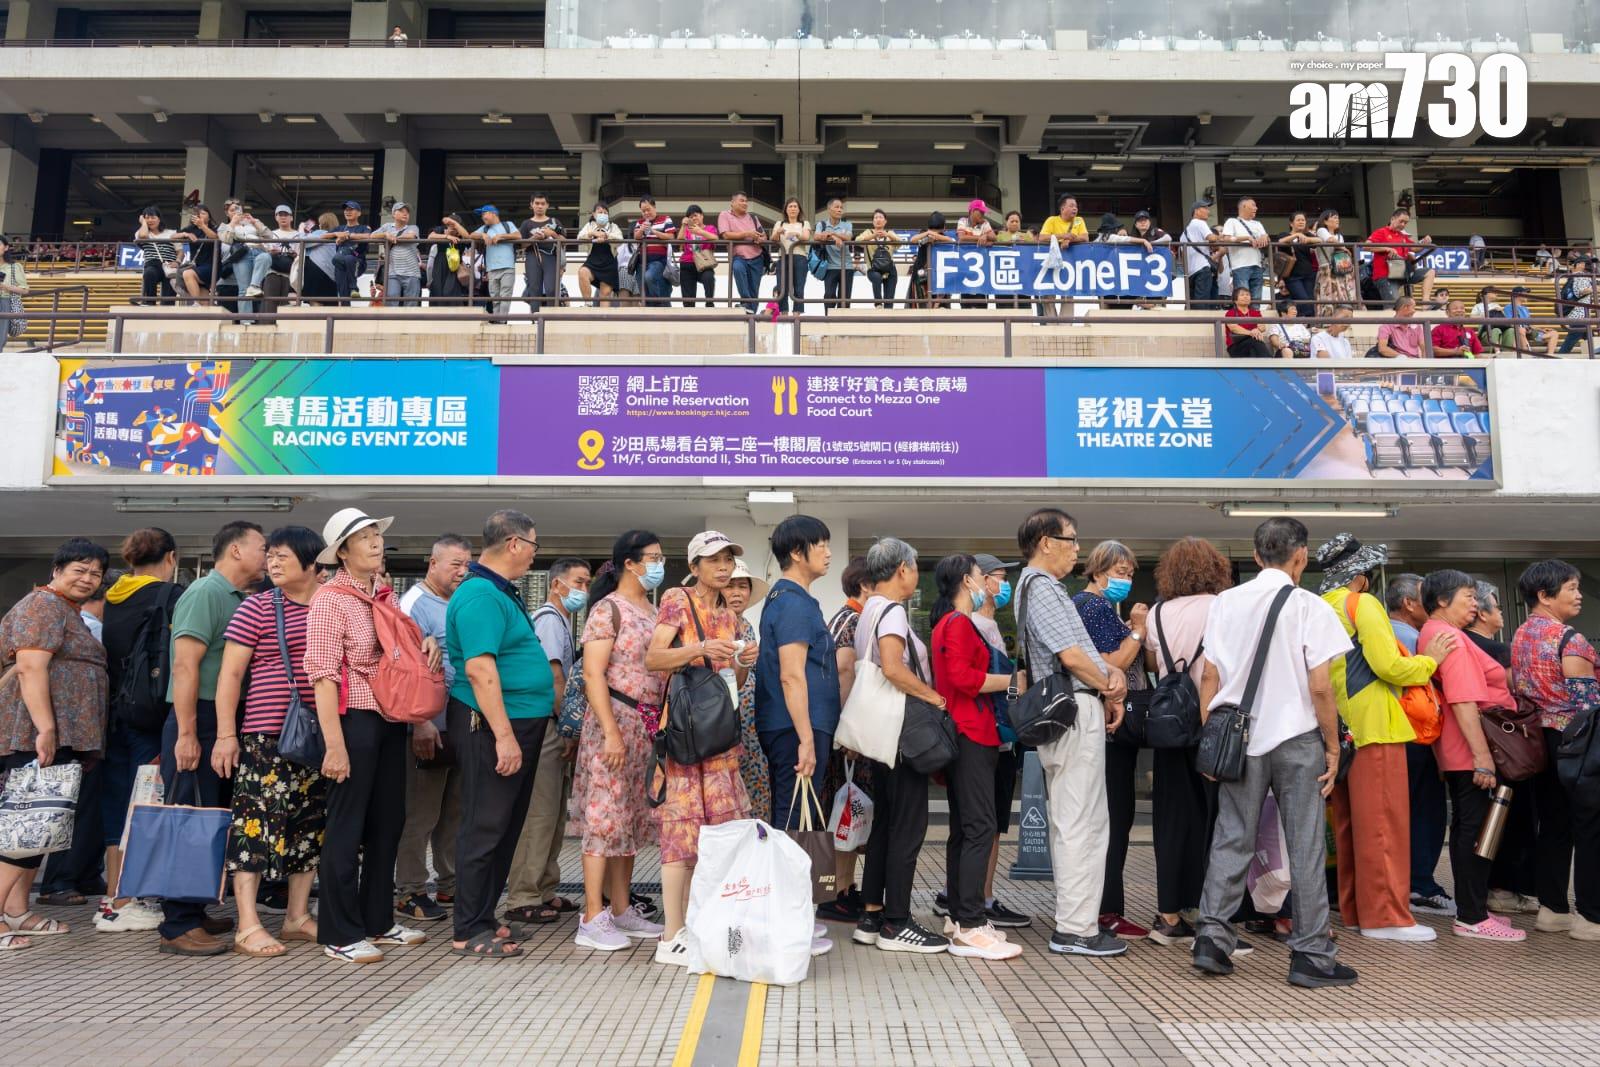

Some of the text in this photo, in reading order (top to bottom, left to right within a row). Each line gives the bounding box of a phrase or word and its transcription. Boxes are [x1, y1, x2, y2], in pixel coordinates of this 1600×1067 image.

[936, 250, 1023, 291] F3區
[626, 375, 699, 394] 網上訂座
[807, 376, 968, 393] 連接「好賞食」美食廣場
[626, 394, 750, 407] Online Reservation
[806, 393, 941, 405] Connect to Mezza One
[263, 396, 468, 427] 賽馬活動專區
[626, 408, 750, 418] https://www.bookingrc.hkjc.com
[806, 406, 873, 417] Food Court
[1078, 397, 1213, 429] 影視大堂
[94, 426, 144, 443] 活動專區
[273, 431, 468, 447] RACING EVENT ZONE
[1076, 431, 1213, 448] THEATRE ZONE
[612, 453, 644, 466] 1M/F,
[647, 453, 718, 465] Grandstand
[734, 453, 757, 465] Sha
[759, 453, 778, 465] Tin
[780, 453, 850, 465] Racecourse
